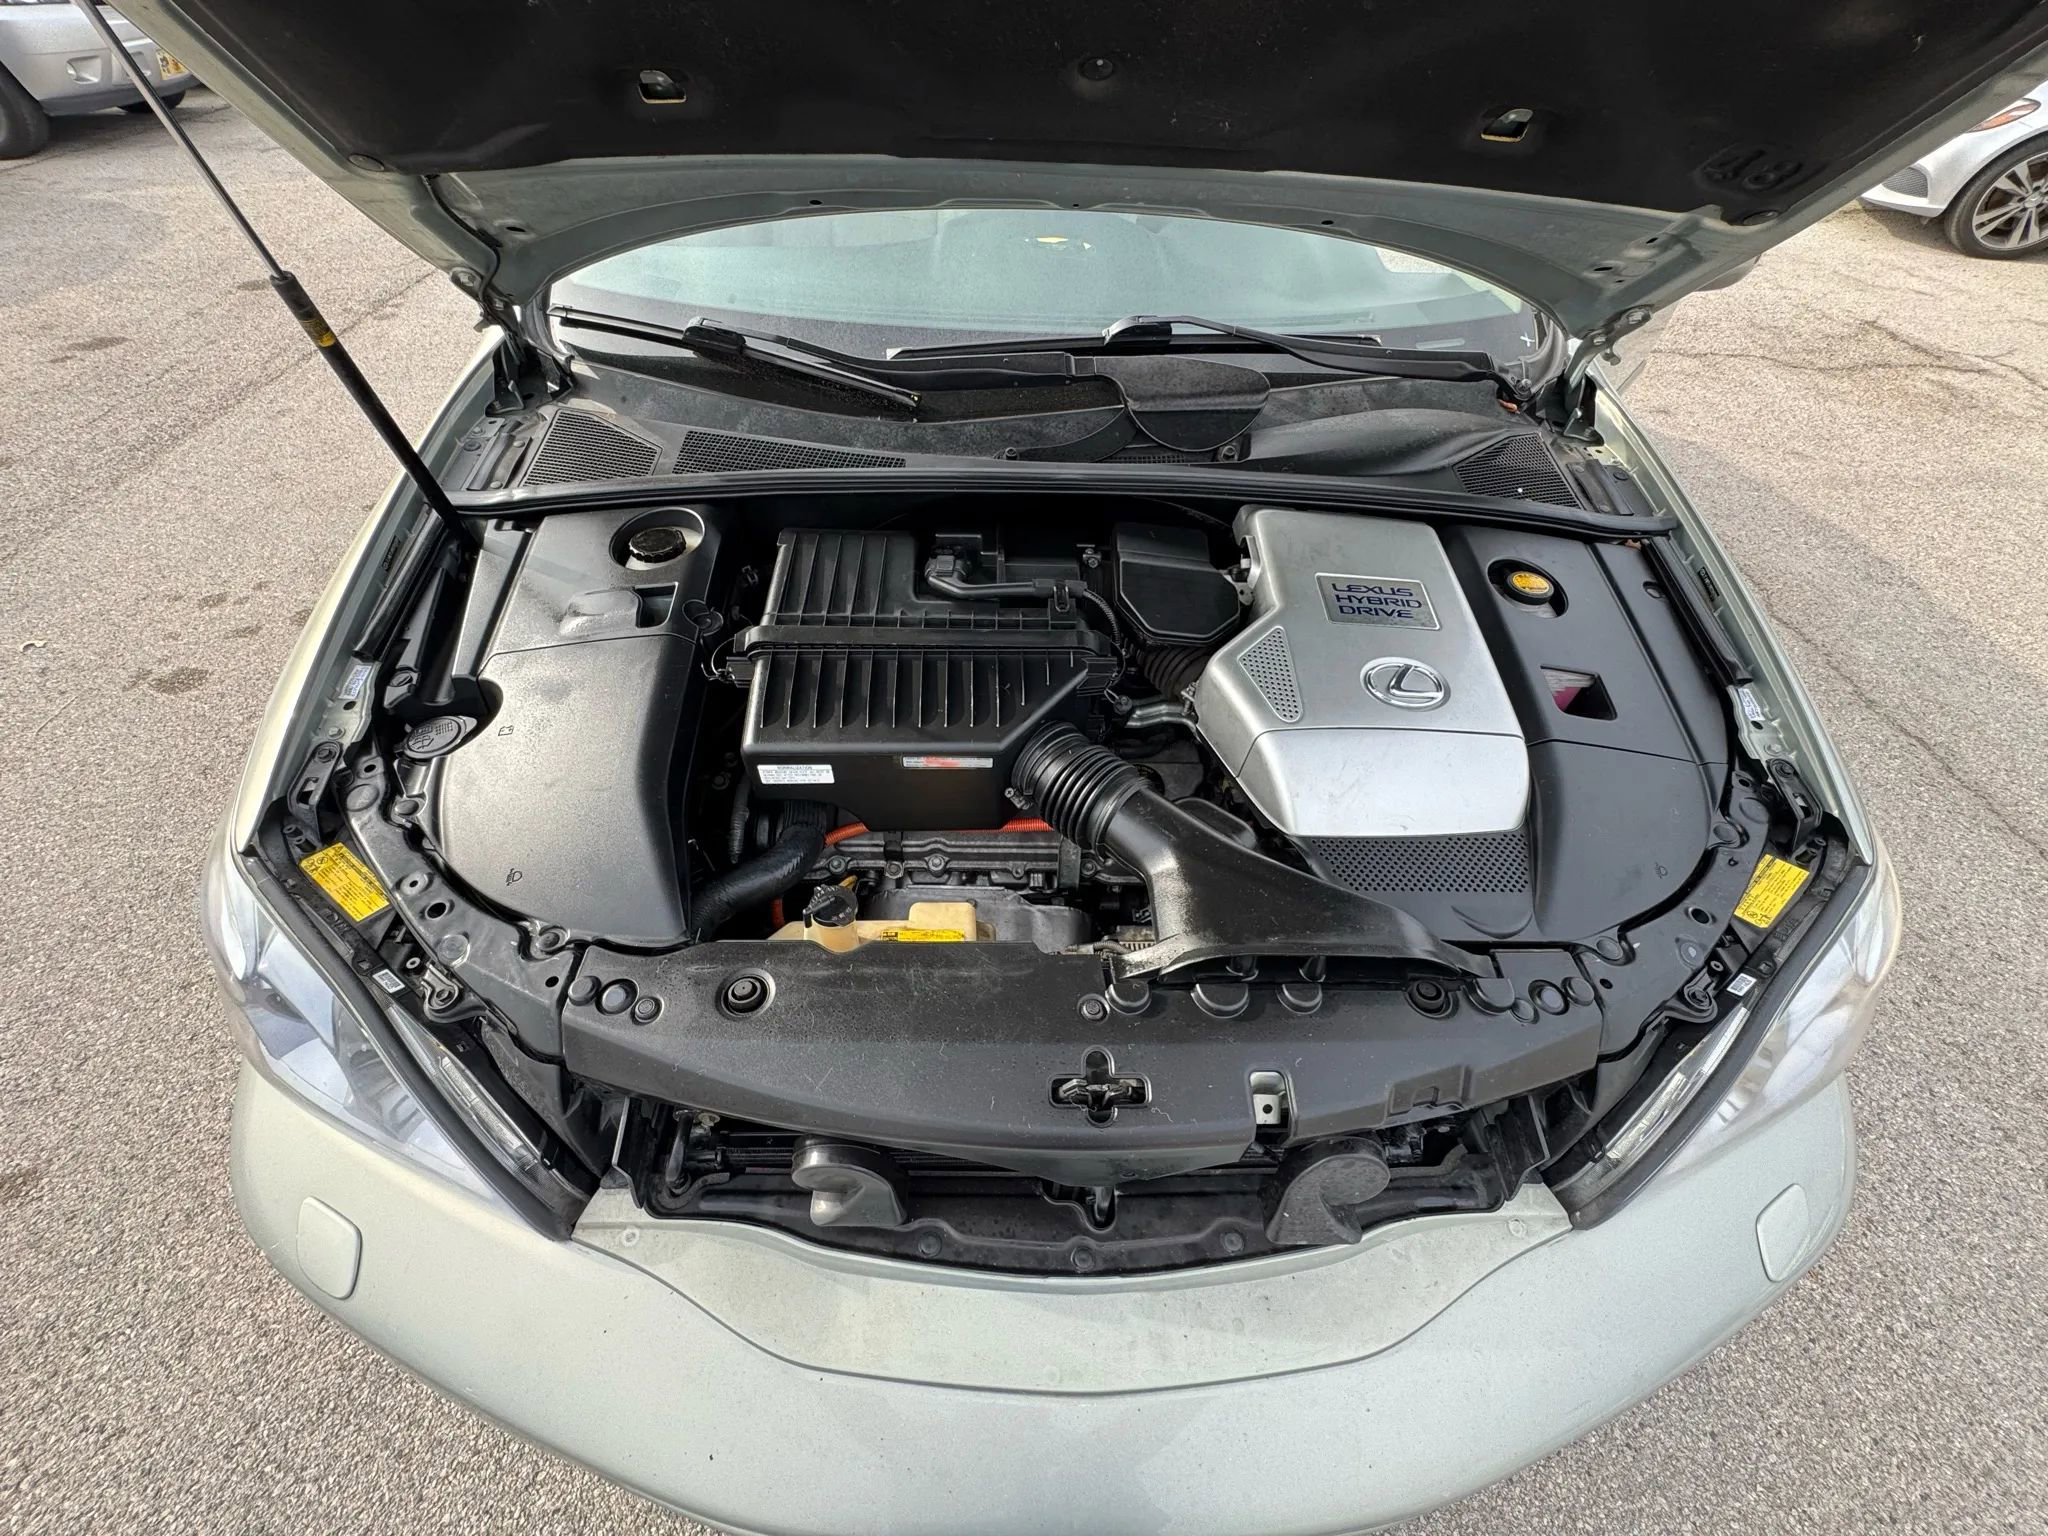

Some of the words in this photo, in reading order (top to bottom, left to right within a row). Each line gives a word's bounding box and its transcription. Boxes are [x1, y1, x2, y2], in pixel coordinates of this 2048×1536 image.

[1331, 583, 1413, 597] LEXUS
[1335, 594, 1422, 609] HYBRID
[1338, 605, 1414, 619] DRIVE
